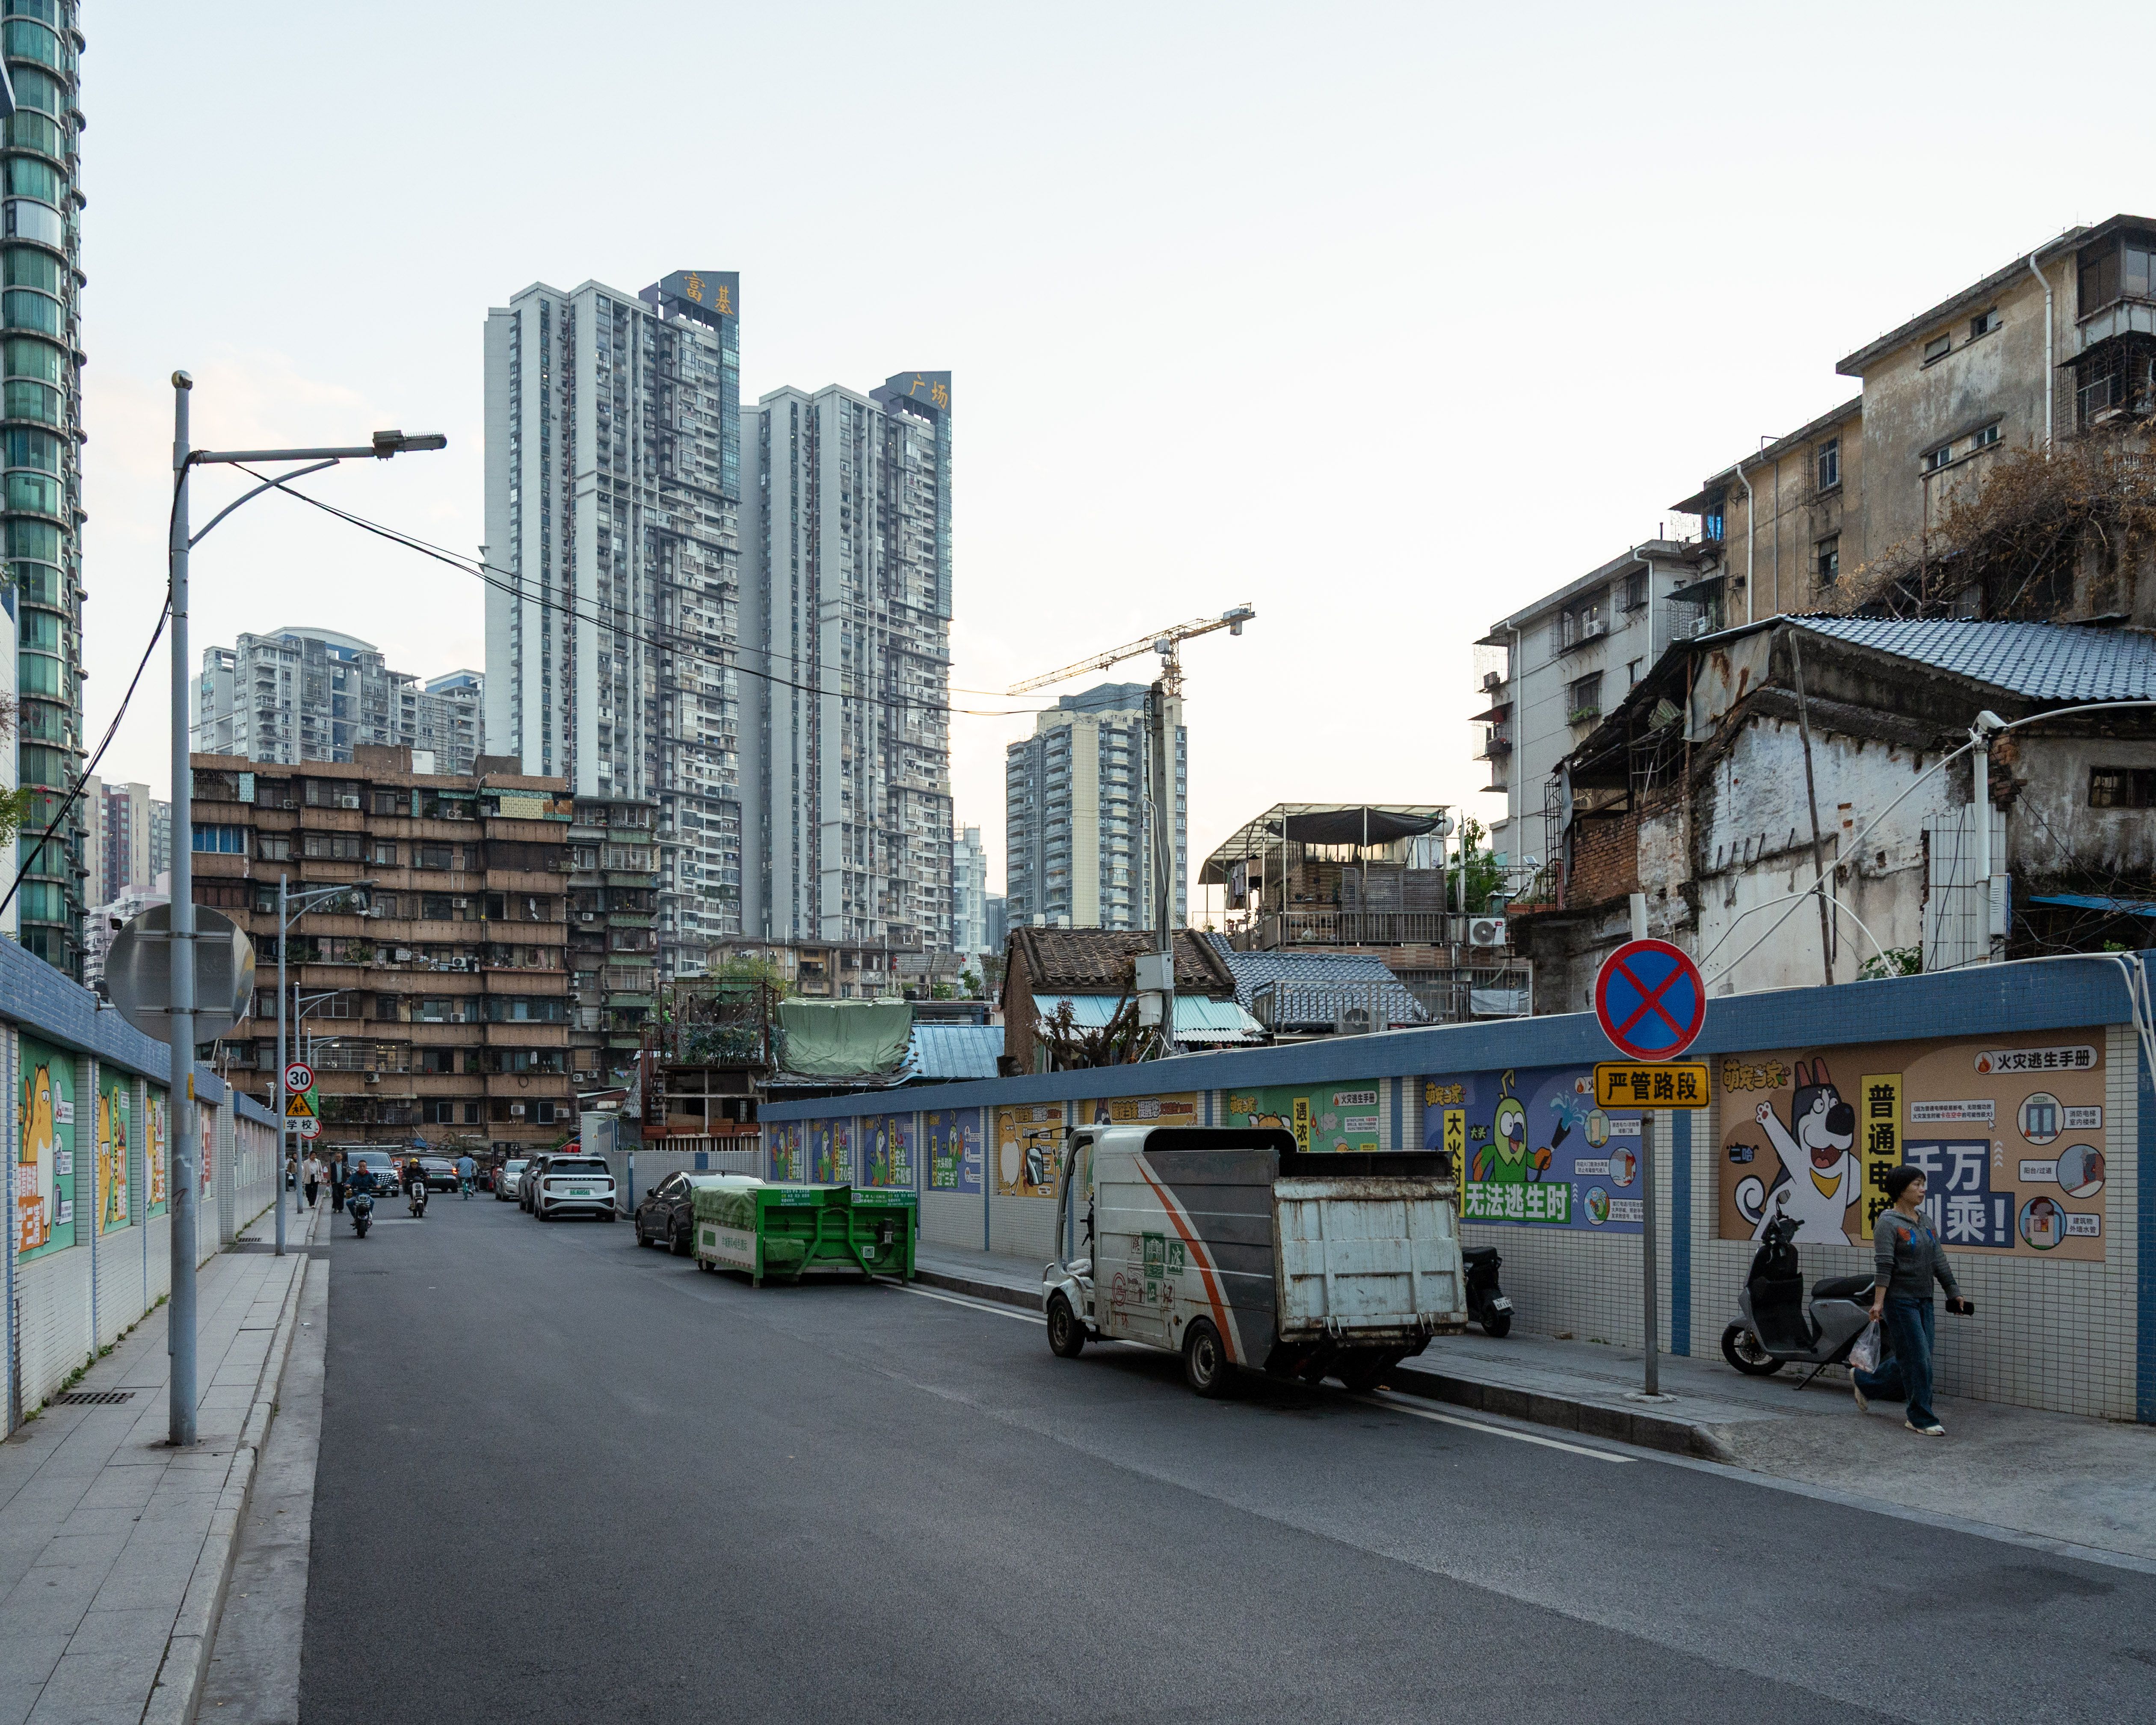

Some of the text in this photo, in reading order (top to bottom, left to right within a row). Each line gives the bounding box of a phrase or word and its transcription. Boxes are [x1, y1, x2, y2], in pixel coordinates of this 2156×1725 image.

[684, 272, 734, 316] 富基
[909, 373, 948, 409] 广场
[1998, 1052, 2090, 1070] 火灾逃生手册
[290, 1071, 309, 1085] 30
[1723, 1059, 1788, 1092] 萌宠当家
[1607, 1071, 1697, 1100] 严管路段
[1341, 1093, 1374, 1104] 火灾逃生手册
[287, 1120, 312, 1130] 学校
[1470, 1128, 1487, 1137] 大头
[895, 1149, 906, 1166] 安全
[1730, 1148, 1753, 1161] 二哈
[1904, 1146, 1985, 1191] 千万
[1466, 1183, 1567, 1220] 无法逃生时
